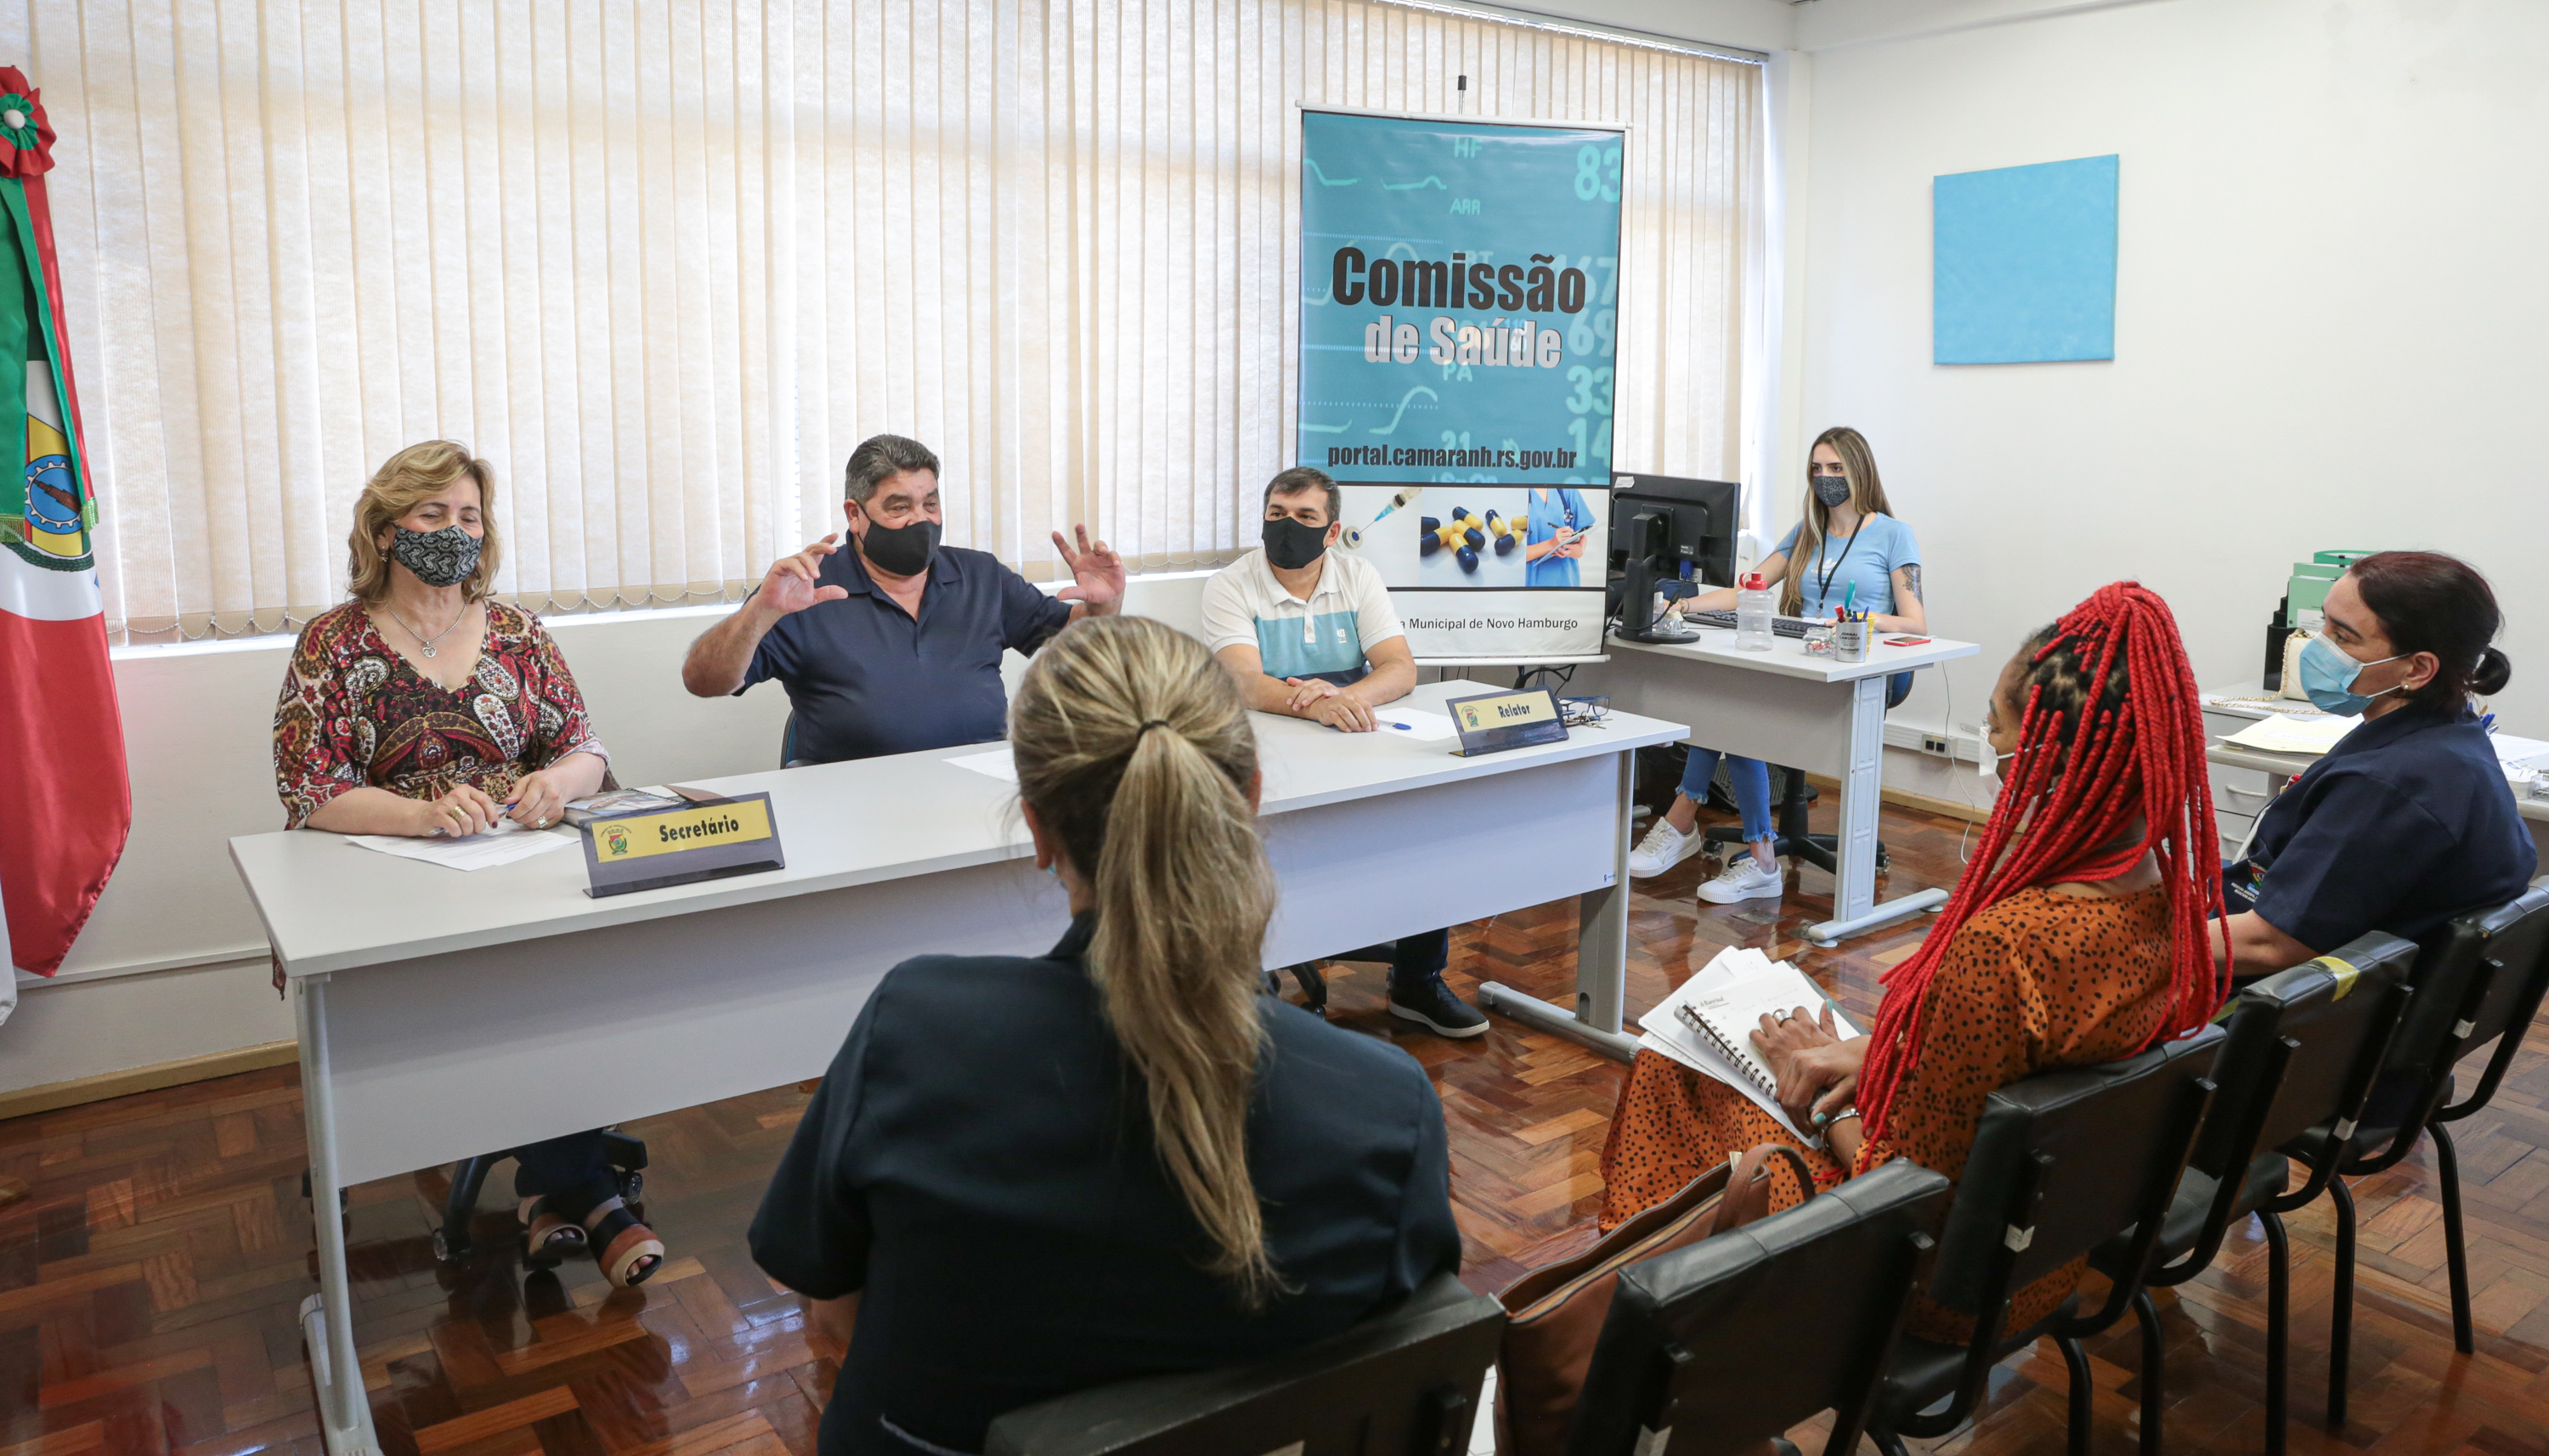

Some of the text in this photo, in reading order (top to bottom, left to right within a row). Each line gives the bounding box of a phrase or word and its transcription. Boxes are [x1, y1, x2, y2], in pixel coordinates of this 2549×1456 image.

[1574, 144, 1622, 203] 83
[1333, 246, 1586, 314] Comissão
[1365, 314, 1563, 369] de Saúde
[1566, 364, 1614, 416] 33
[1328, 444, 1577, 471] portal.camaranh.rs.gov.br
[1568, 416, 1613, 468] 14
[1410, 618, 1466, 631] Municipal
[1469, 618, 1483, 629] de
[1487, 618, 1515, 629] Novo
[1518, 618, 1579, 630] Hamburgo
[1497, 703, 1530, 718] Relator
[659, 814, 739, 842] Secretário
